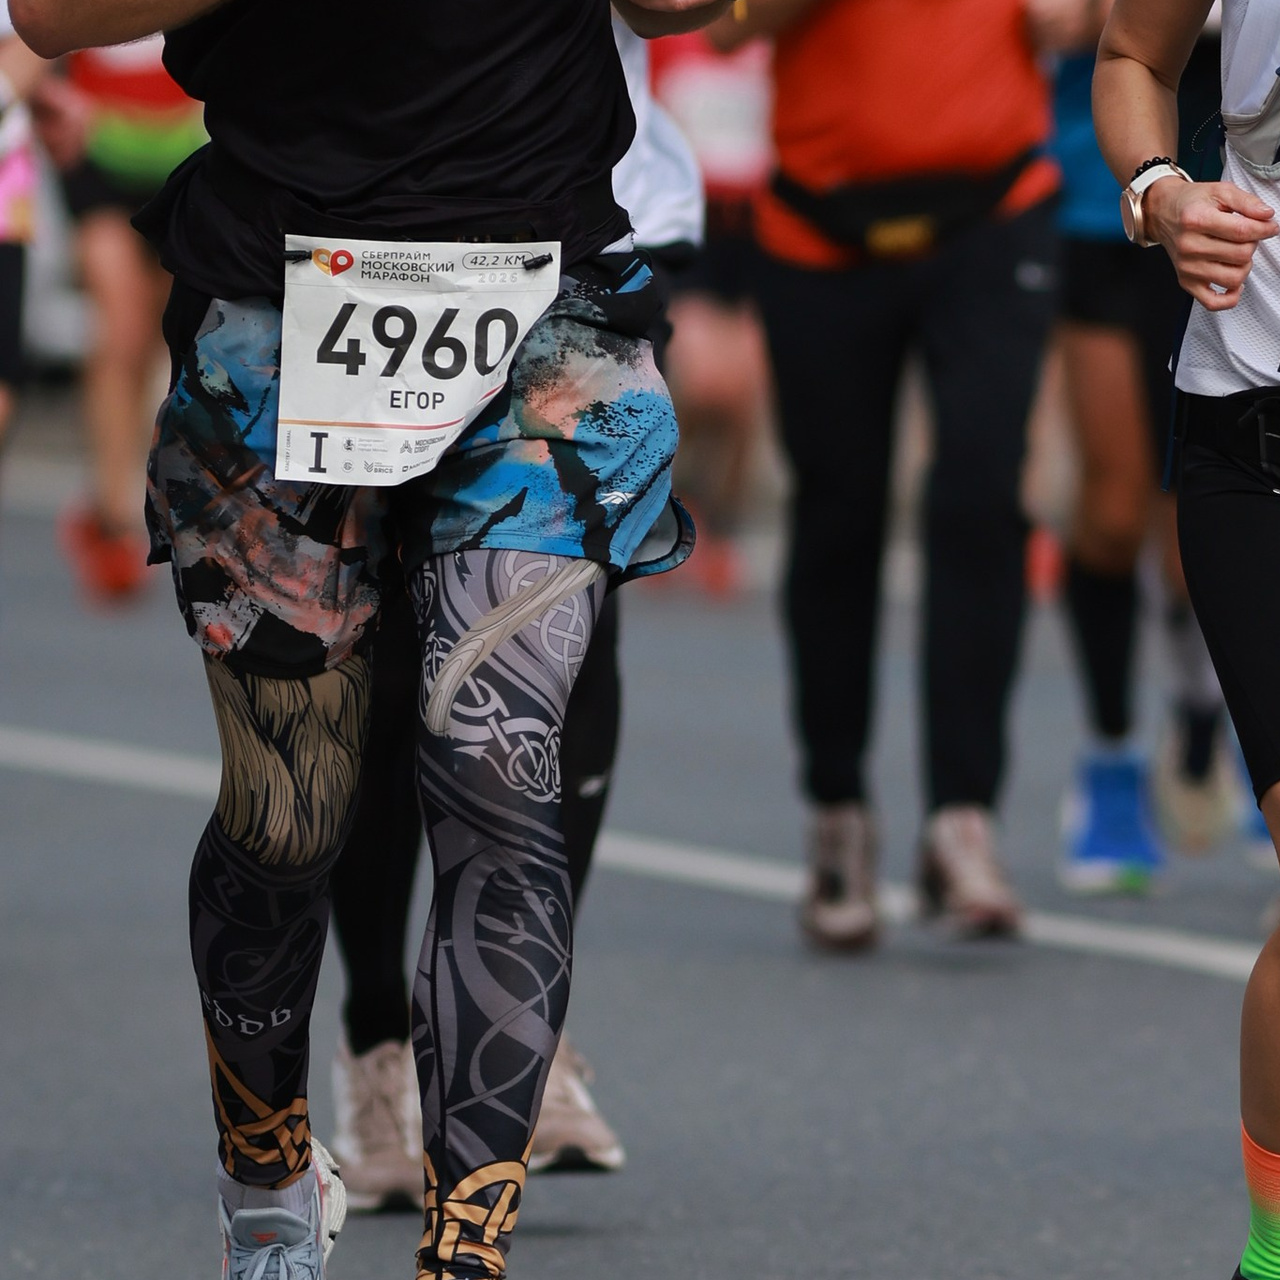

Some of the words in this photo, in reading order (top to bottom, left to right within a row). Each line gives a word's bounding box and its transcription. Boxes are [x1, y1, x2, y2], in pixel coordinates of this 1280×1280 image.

[361, 250, 431, 260] СБЕРПРАЙМ
[470, 255, 499, 267] 42,2
[361, 260, 455, 273] МОСКОВСКИЙ
[361, 271, 430, 283] МАРАФОН
[317, 303, 519, 380] 4960
[390, 390, 445, 410] ЕГОР
